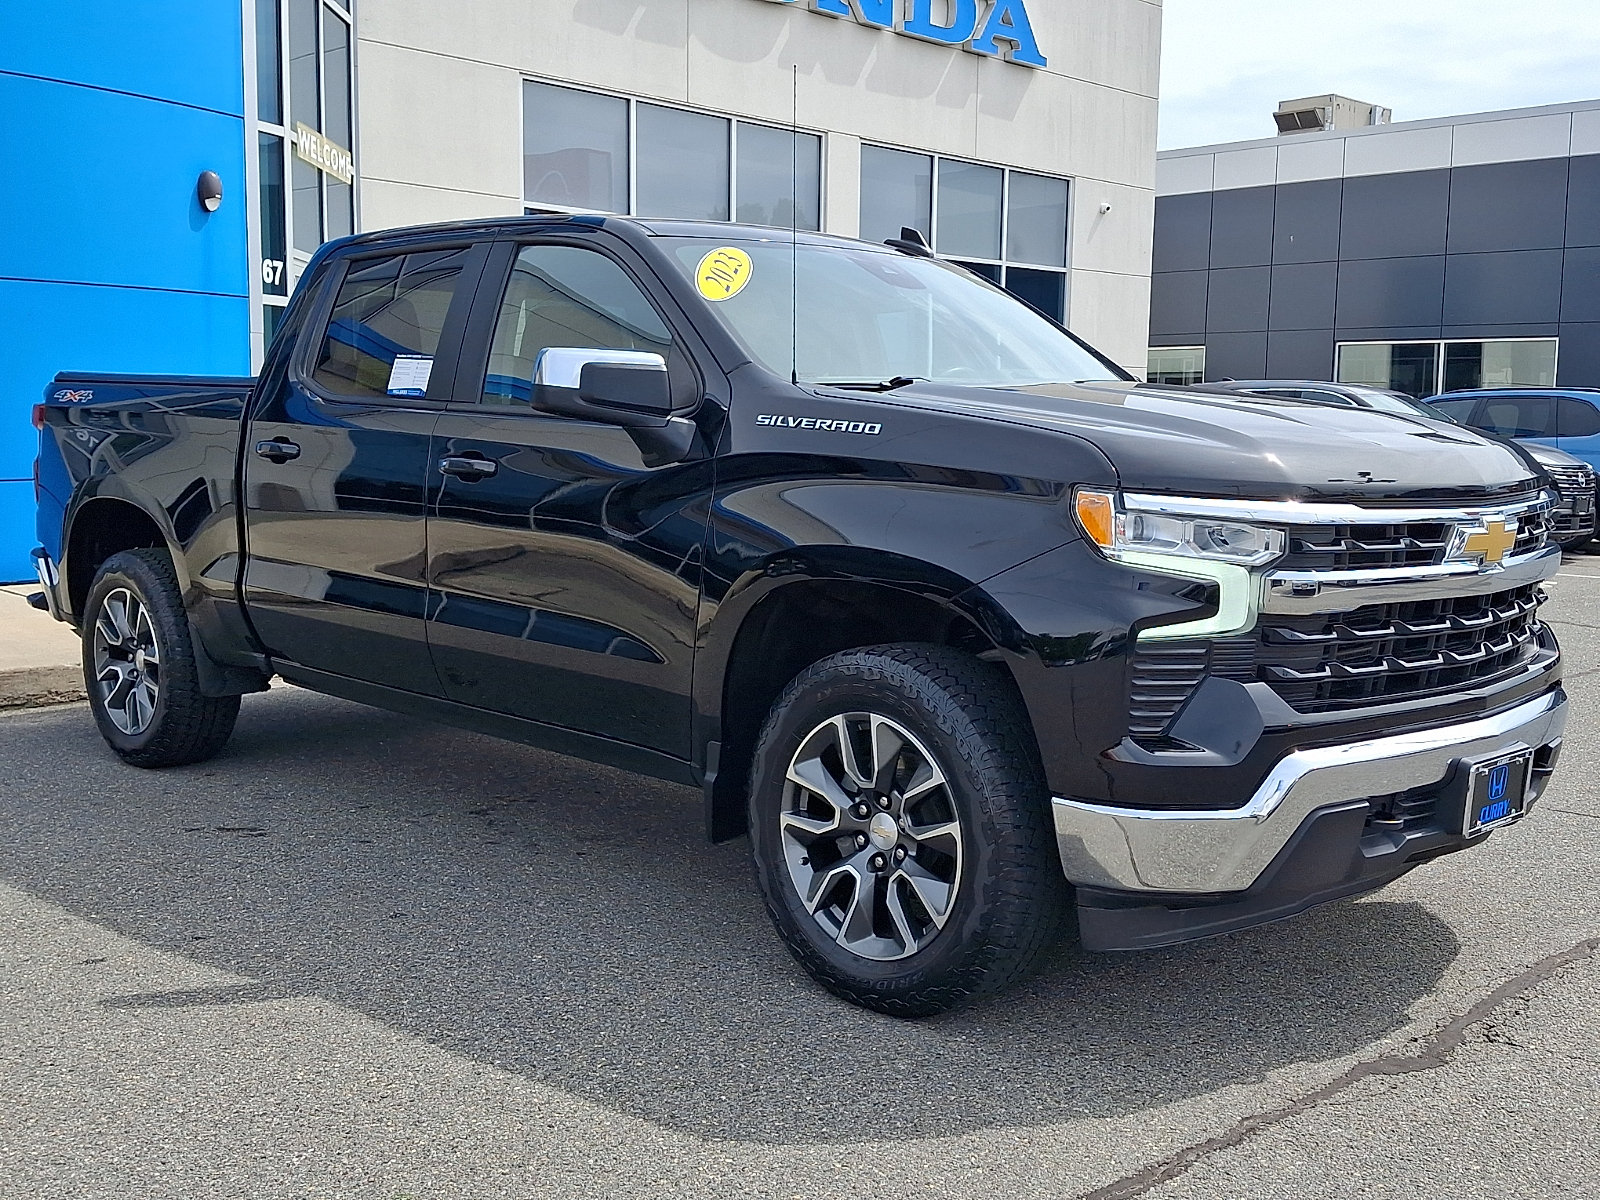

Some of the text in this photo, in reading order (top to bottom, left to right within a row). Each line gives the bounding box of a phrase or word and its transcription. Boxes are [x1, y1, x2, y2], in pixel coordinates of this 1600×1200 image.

[781, 0, 1048, 68] DA
[297, 127, 352, 179] WELCOME
[262, 258, 284, 286] 67
[705, 252, 743, 293] 2023
[755, 414, 882, 436] SILVERADO
[1480, 799, 1511, 823] CURRY
